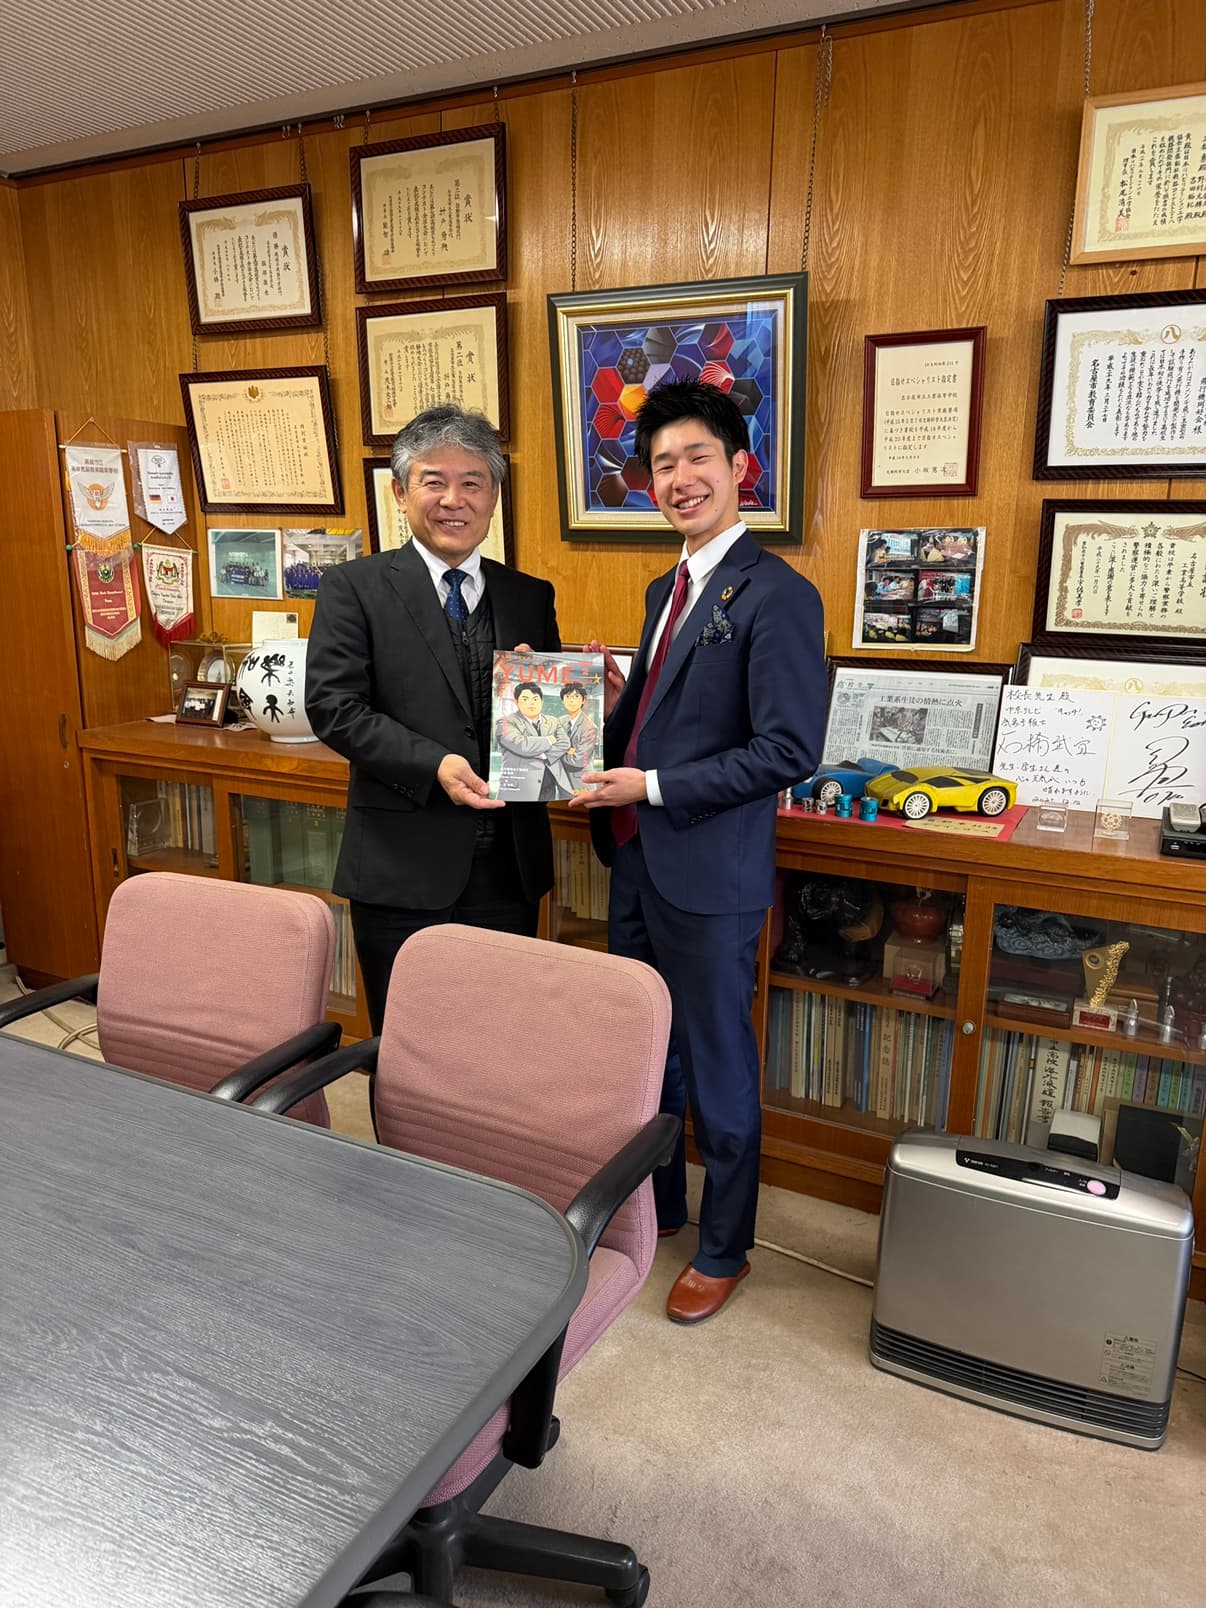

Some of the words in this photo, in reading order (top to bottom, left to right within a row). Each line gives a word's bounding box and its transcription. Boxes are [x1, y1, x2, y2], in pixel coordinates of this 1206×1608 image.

[466, 350, 476, 383] 賞状
[890, 374, 957, 386] 目指せスペシャリスト指定書
[1085, 359, 1100, 429] 名古屋市教育委員会
[880, 696, 962, 707] 工業系生徒の情熱に点火
